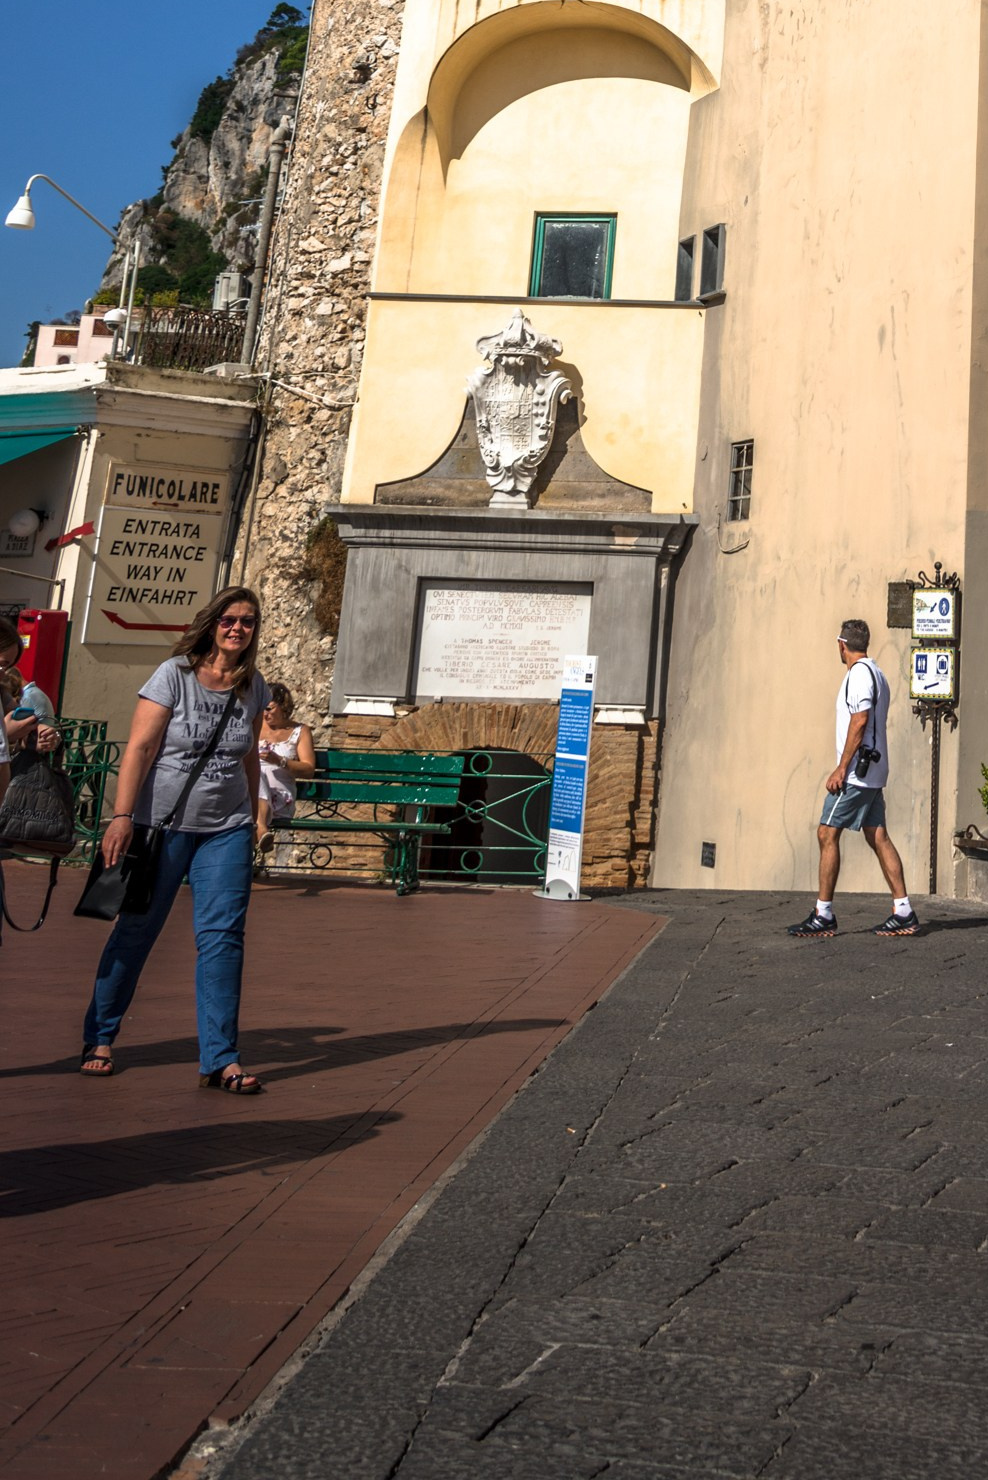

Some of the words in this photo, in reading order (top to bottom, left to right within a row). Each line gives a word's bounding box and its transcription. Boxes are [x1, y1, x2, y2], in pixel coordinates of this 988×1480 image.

[112, 473, 220, 504] FUNICOLARE
[122, 518, 200, 539] ENTRATA
[109, 540, 207, 561] ENTRANCE
[127, 564, 163, 581] WAY
[166, 567, 187, 582] IN
[107, 586, 198, 606] EINFAHRT
